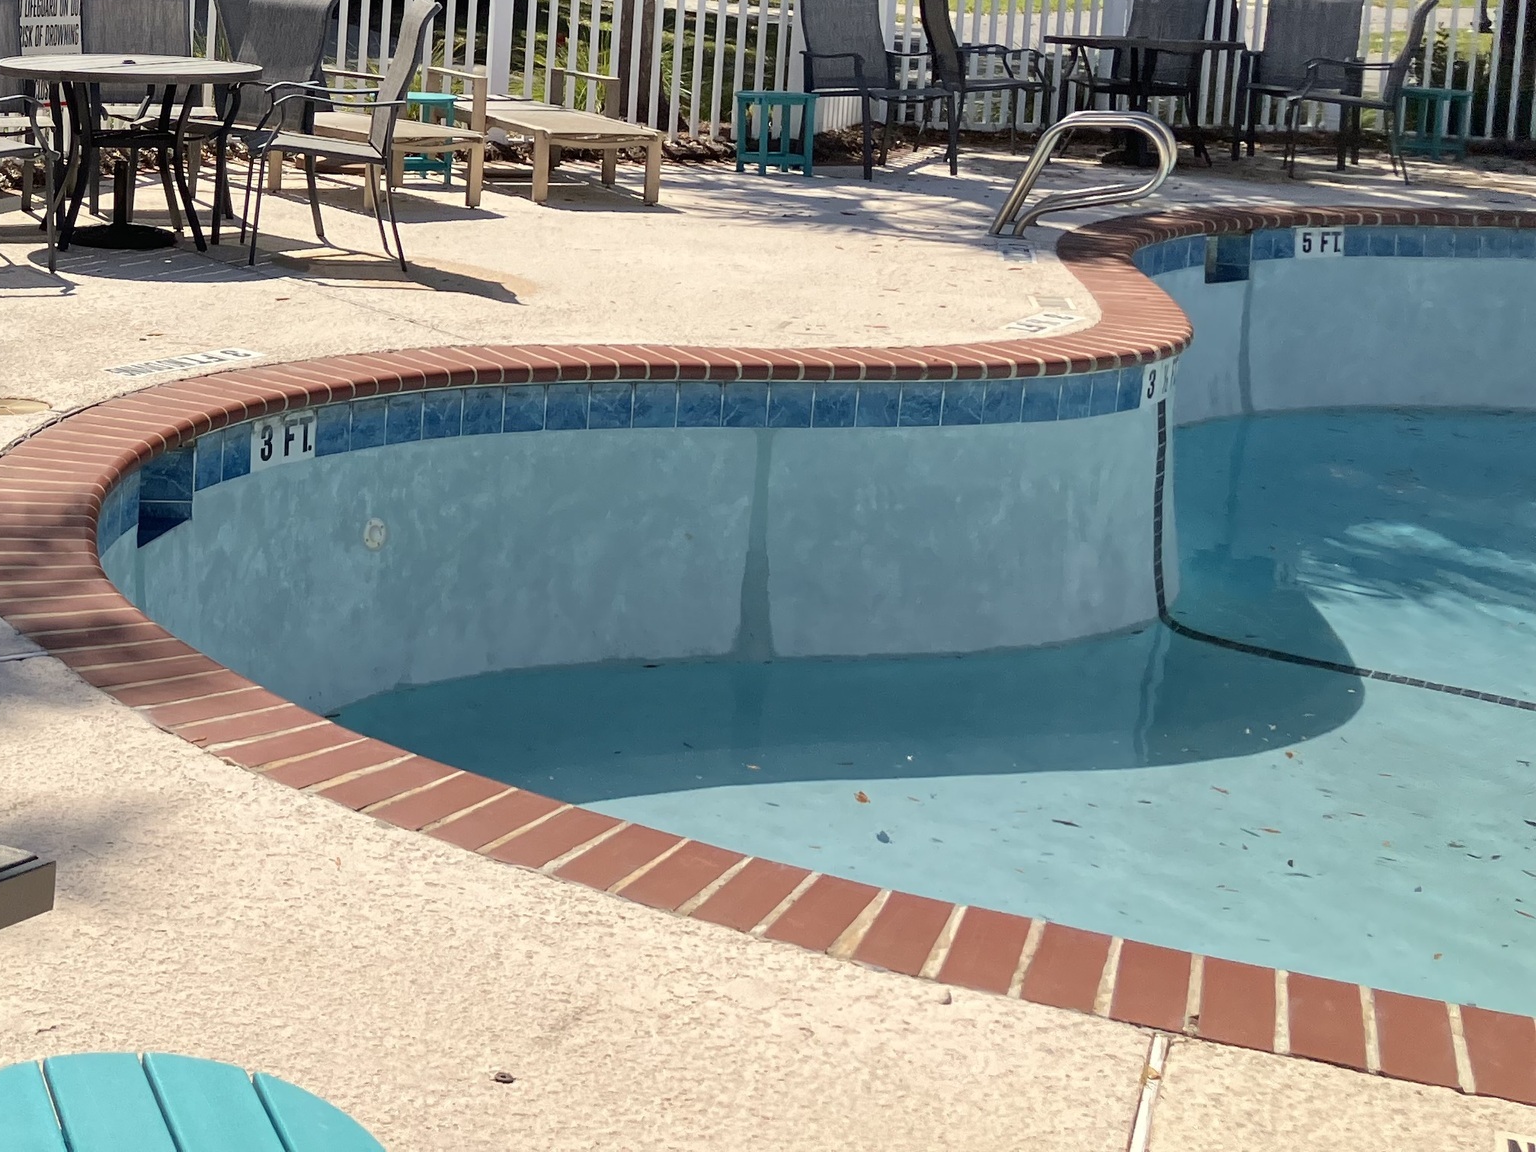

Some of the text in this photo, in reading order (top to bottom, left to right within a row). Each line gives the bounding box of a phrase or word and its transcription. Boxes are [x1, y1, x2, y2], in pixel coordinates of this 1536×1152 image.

[34, 24, 43, 47] OF
[44, 23, 79, 46] DROWNING
[1302, 232, 1312, 253] 5
[1147, 369, 1157, 399] 3
[260, 424, 274, 462] 3
